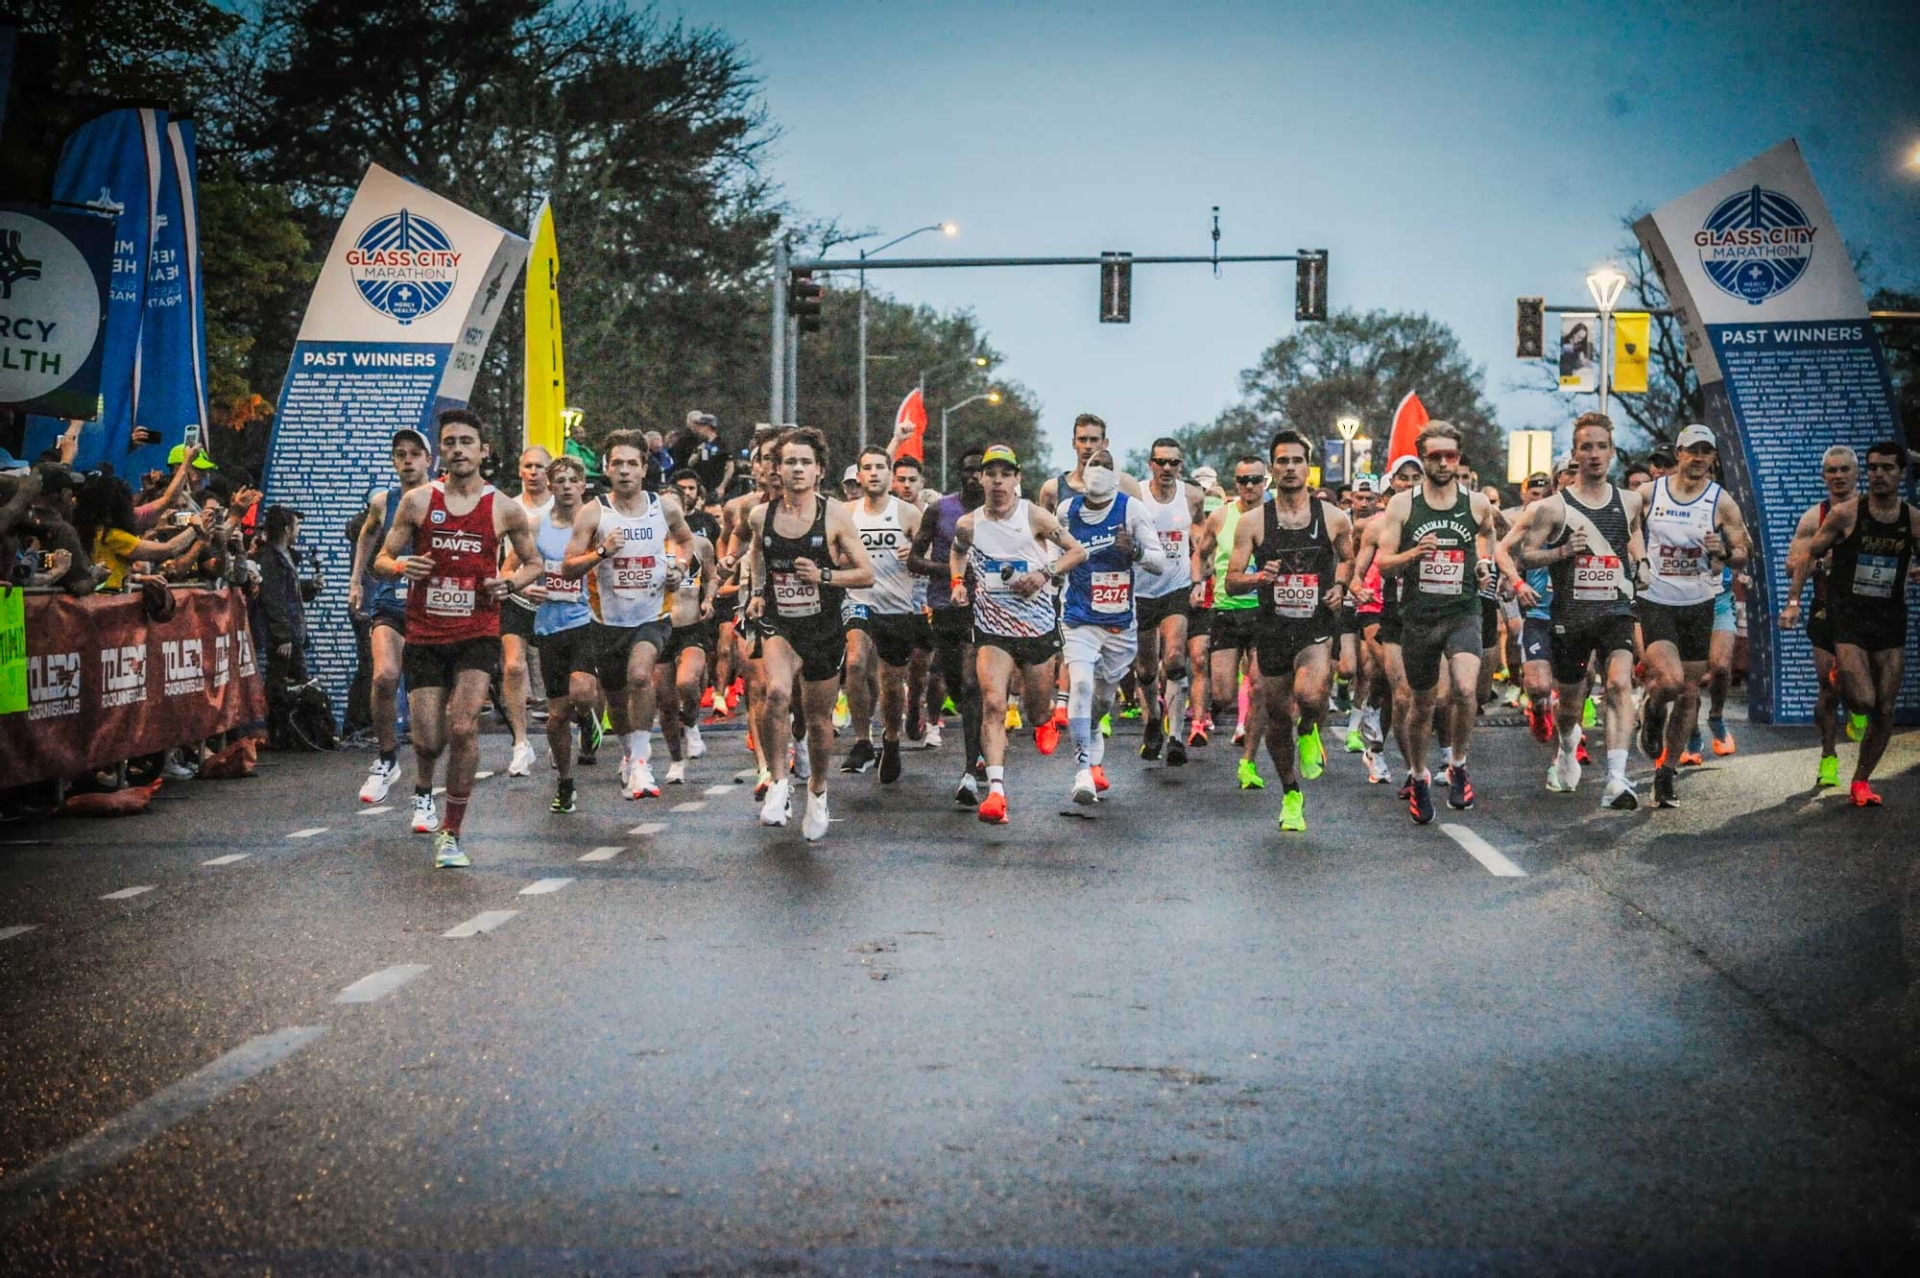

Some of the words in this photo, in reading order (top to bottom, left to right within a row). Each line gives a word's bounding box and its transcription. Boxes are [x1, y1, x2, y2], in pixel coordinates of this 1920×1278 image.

[1694, 230, 1762, 246] GLASS
[1769, 227, 1818, 244] CITY
[346, 250, 410, 266] GLASS
[417, 252, 462, 267] CITY
[1714, 245, 1799, 259] MARATHON
[364, 267, 446, 279] MARATHON
[1722, 329, 1768, 344] PAST
[1774, 327, 1864, 343] WINNERS
[303, 352, 348, 366] PAST
[352, 352, 436, 367] WINNERS
[622, 527, 653, 541] OLEDO
[1412, 520, 1448, 542] MERRIMAN
[1450, 520, 1472, 542] VALLEY
[432, 537, 482, 554] DAVE'S
[1424, 564, 1459, 576] 2027
[1662, 559, 1698, 568] 2004
[618, 570, 652, 581] 2025
[1578, 570, 1614, 581] 2026
[1872, 568, 1881, 579] 2
[432, 591, 468, 604] 2001
[777, 586, 815, 598] 2040
[1093, 588, 1128, 602] 2474
[1278, 588, 1314, 600] 2009
[26, 652, 80, 702] OLEDO
